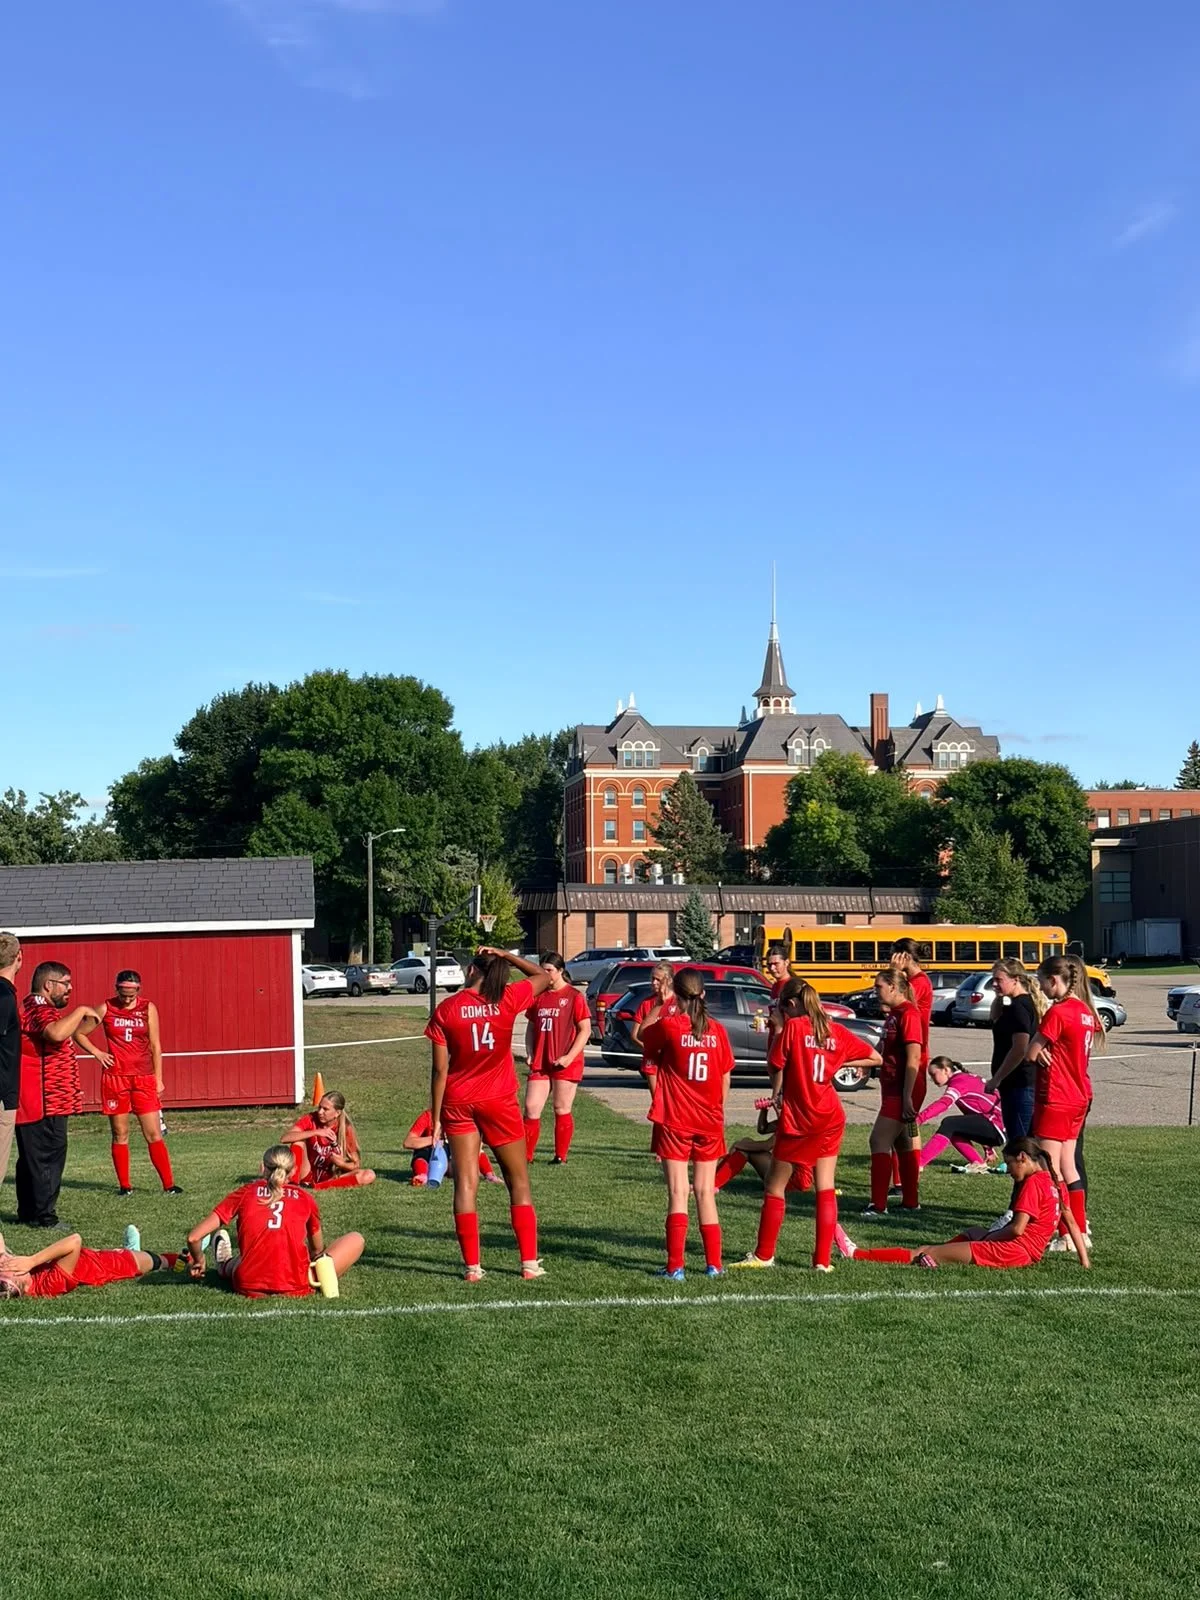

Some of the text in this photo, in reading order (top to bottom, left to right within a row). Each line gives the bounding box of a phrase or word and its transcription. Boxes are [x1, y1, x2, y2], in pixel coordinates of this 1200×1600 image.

[461, 1004, 500, 1019] COMETS
[537, 1008, 560, 1017] COMETS
[114, 1018, 144, 1027] COMETS
[541, 1018, 553, 1032] 20
[125, 1028, 133, 1042] 6
[472, 1022, 496, 1052] 14
[804, 1035, 836, 1051] COTS
[688, 1052, 708, 1082] 16
[813, 1053, 825, 1083] 11
[267, 1201, 284, 1229] 3
